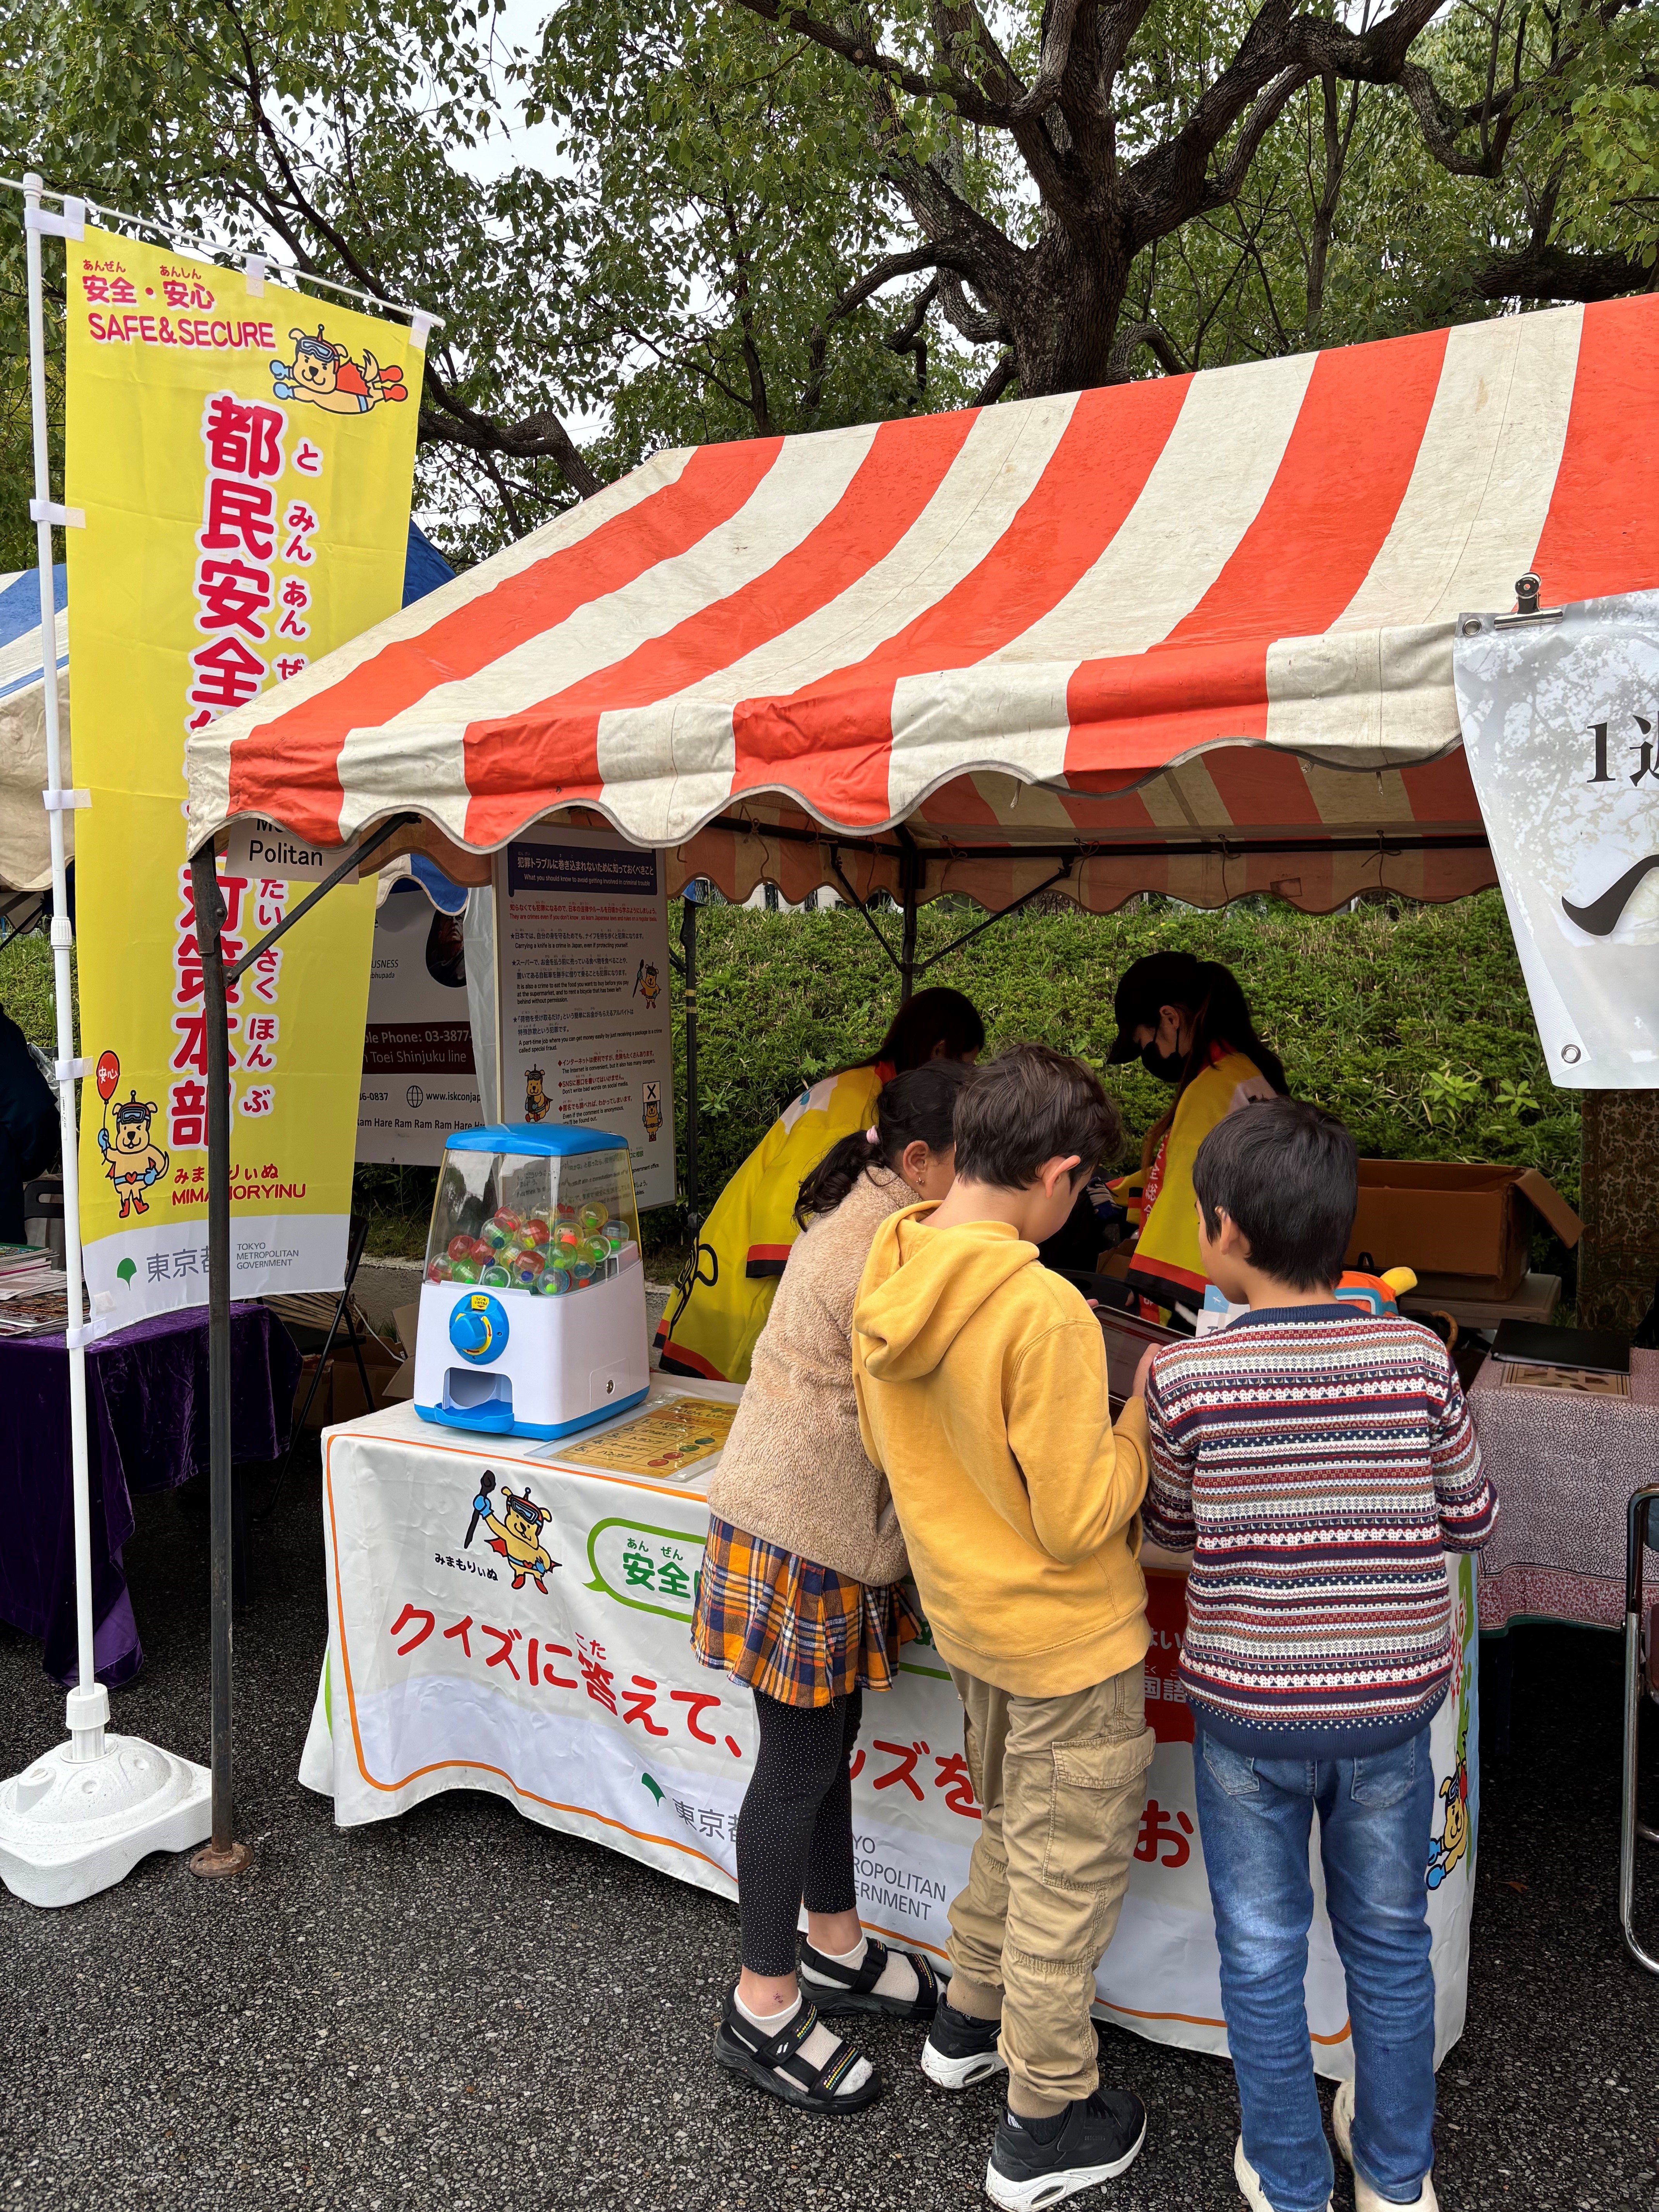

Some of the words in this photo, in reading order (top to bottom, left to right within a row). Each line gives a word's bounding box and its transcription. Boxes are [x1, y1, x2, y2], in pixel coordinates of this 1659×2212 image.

[83, 259, 126, 273] あんぜん
[159, 264, 202, 280] あんしん
[82, 275, 214, 309] 安全・安心
[89, 313, 276, 348] SAFE&SECURE
[249, 840, 323, 866] Politan
[381, 1031, 422, 1043] Phone:
[370, 1051, 394, 1063] Toei
[397, 1050, 445, 1065] Shinjuku
[448, 1049, 466, 1063] line
[99, 1066, 118, 1084] 安心
[374, 1118, 392, 1128] Hare
[395, 1118, 412, 1128] Ram
[414, 1119, 432, 1129] Ram
[434, 1120, 452, 1130] Ram
[454, 1121, 472, 1130] Hare
[172, 1183, 306, 1206] MIMORYINU
[237, 1242, 266, 1251] TOKYO
[237, 1250, 299, 1261] METROPOLITAN
[237, 1259, 293, 1270] GOVERNMENT
[627, 1537, 649, 1552] あん
[660, 1546, 684, 1561] ぜん
[575, 1631, 606, 1661] こた
[390, 1603, 742, 1759] クイズに答えて、
